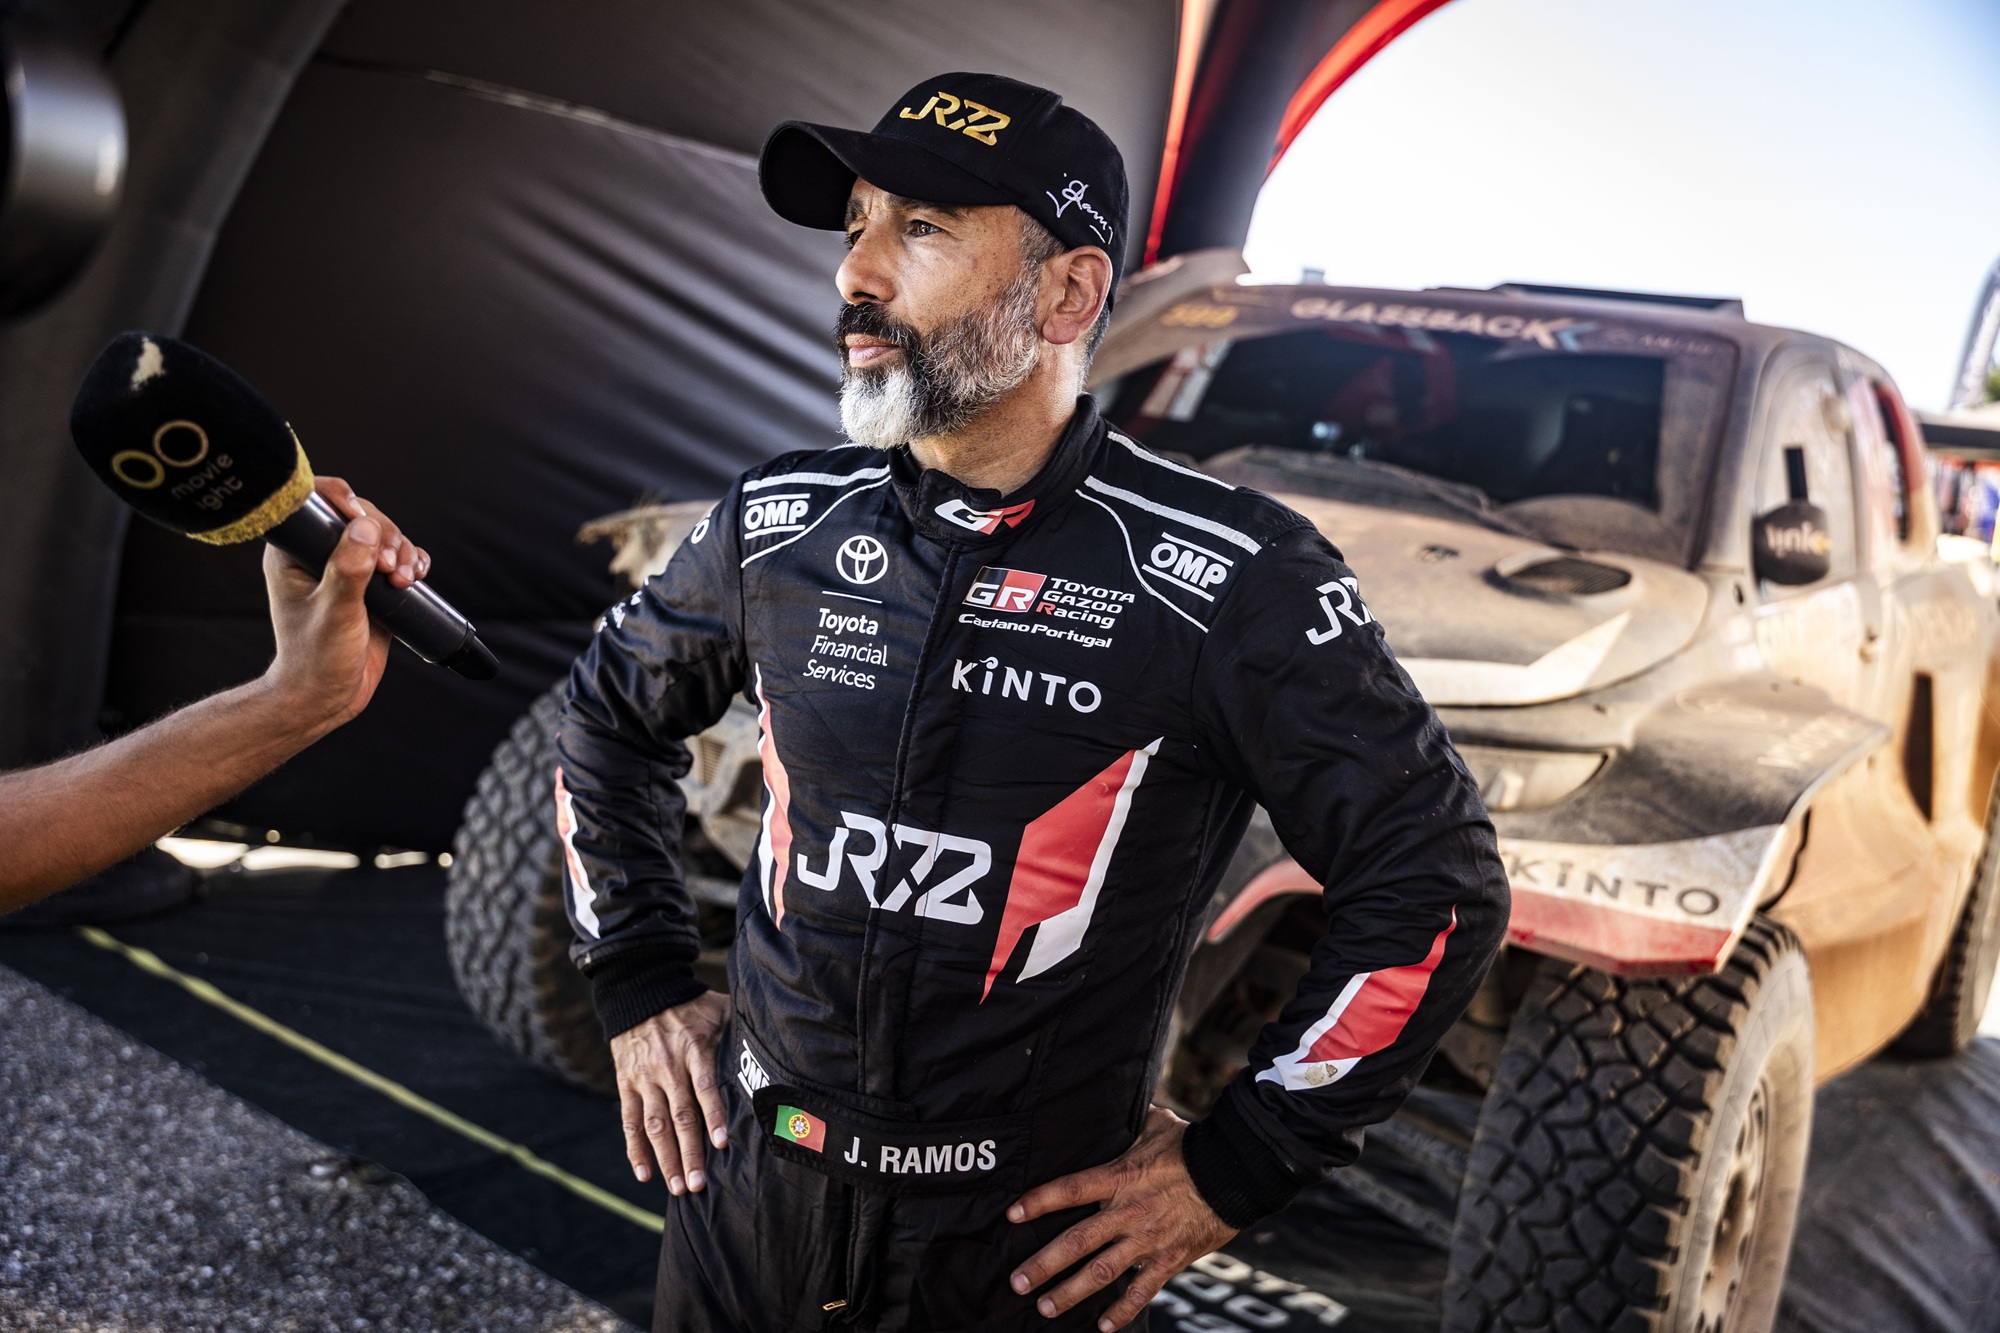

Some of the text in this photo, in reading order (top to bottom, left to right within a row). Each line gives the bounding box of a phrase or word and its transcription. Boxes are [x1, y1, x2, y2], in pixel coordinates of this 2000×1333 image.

[171, 453, 234, 500] movie
[744, 500, 809, 530] OMP
[1150, 542, 1228, 589] OMP
[965, 582, 1035, 610] GR
[1042, 590, 1123, 614] GAZOO
[1050, 577, 1136, 603] TOYOTA
[819, 607, 879, 635] Toyota
[958, 613, 1113, 648] Caetano Portugal
[1036, 601, 1116, 629] Racing
[811, 634, 888, 667] Financial
[803, 659, 876, 691] Services
[843, 1136, 997, 1174] J. RAMOS
